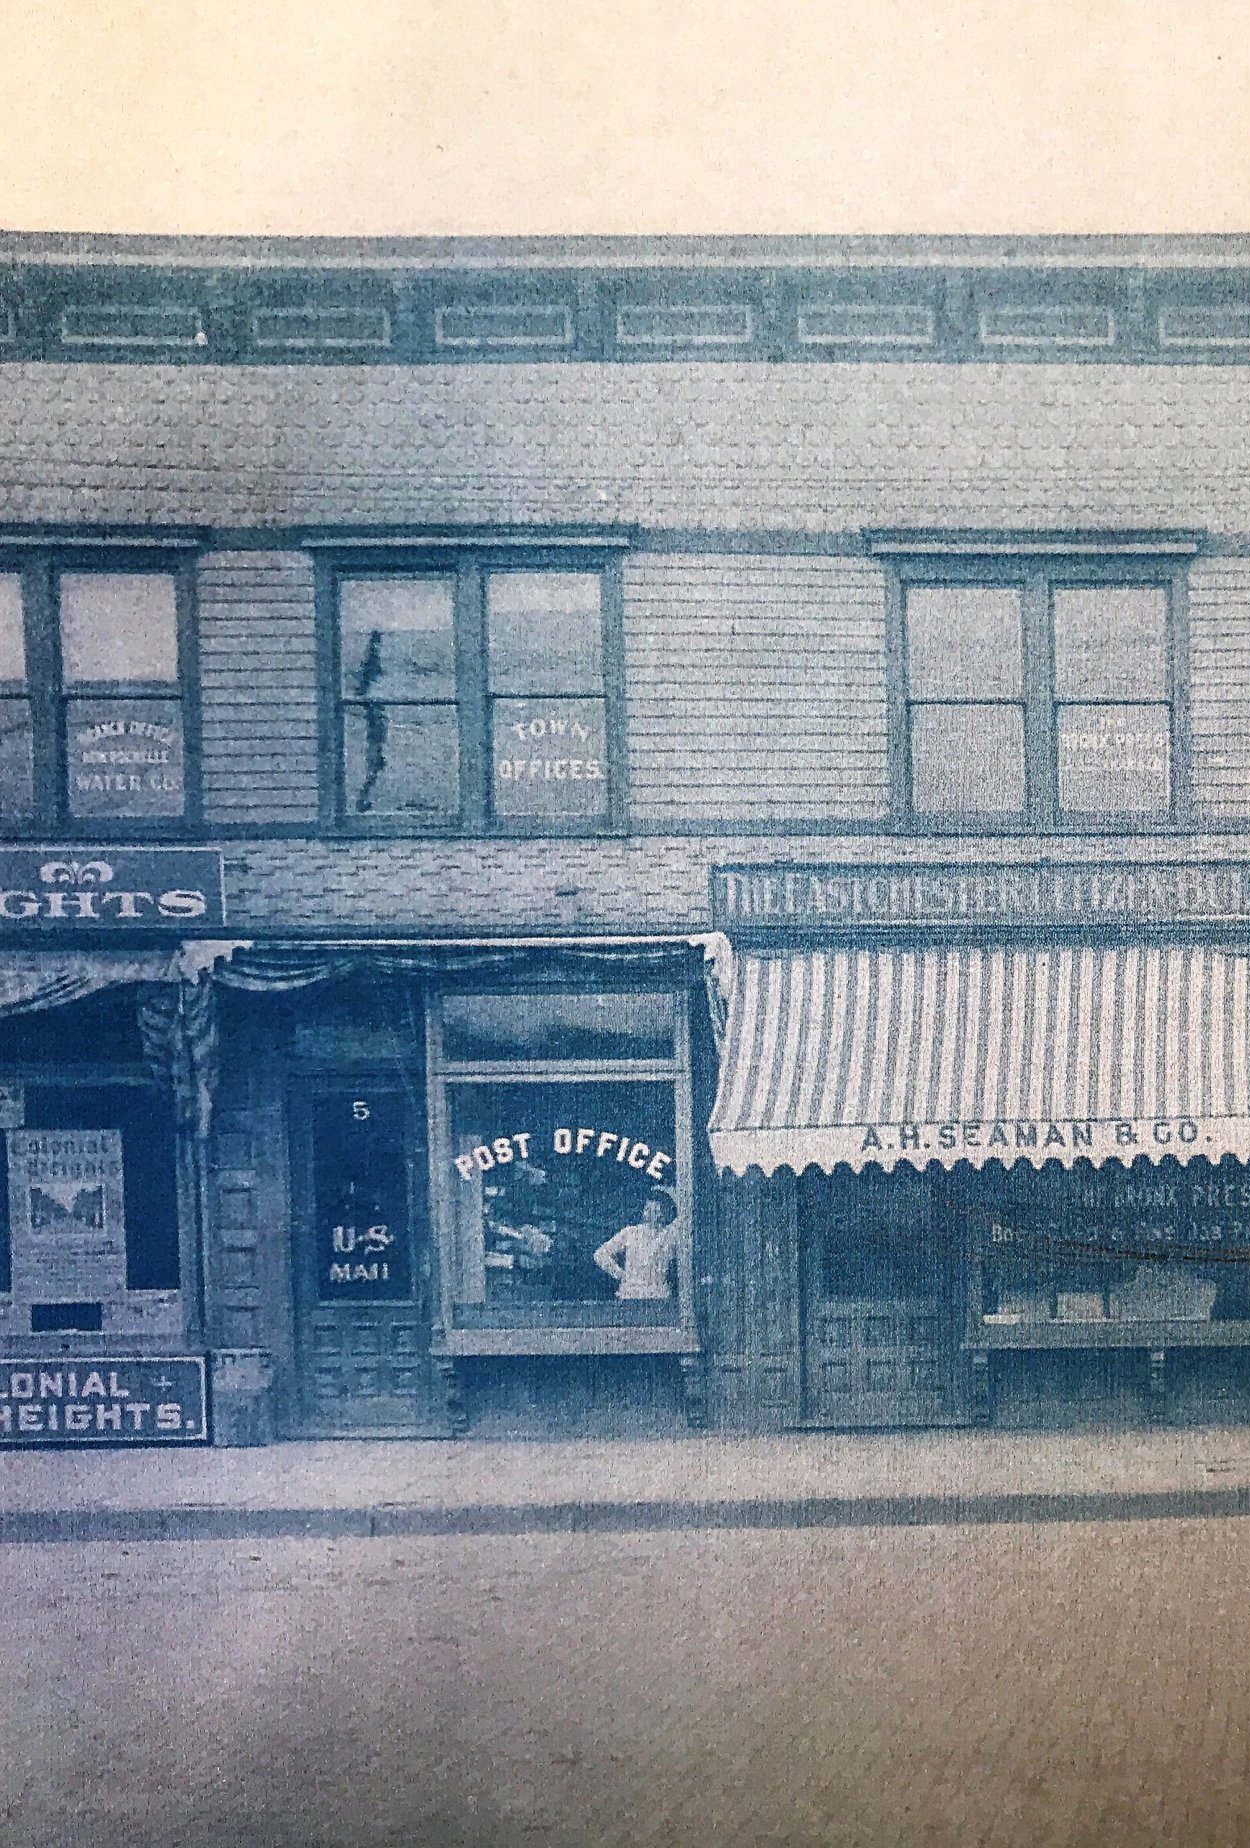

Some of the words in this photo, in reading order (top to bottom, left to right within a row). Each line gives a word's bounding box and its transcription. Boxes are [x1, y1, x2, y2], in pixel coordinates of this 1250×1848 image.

[352, 1101, 371, 1120] 5
[1115, 1121, 1138, 1147] &
[454, 1132, 531, 1181] POST
[553, 1128, 672, 1181] OFFICE
[0, 1371, 130, 1398] ONIAL
